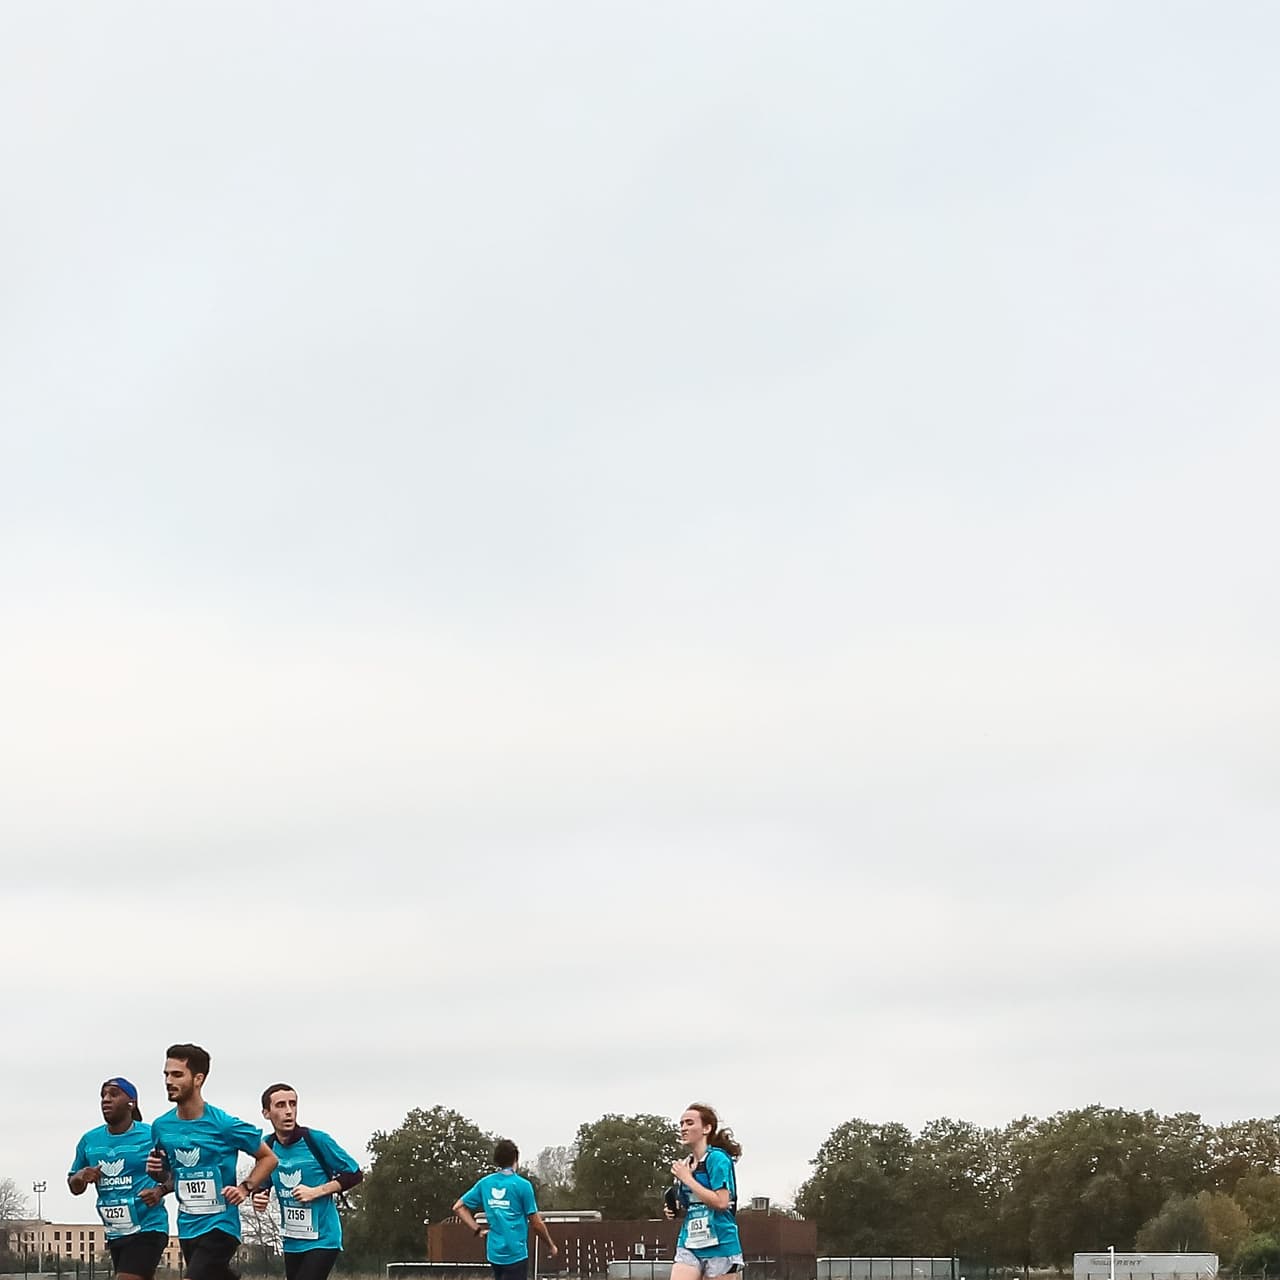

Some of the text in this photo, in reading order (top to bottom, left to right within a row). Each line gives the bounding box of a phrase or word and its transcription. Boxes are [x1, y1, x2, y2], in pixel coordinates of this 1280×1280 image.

[186, 1181, 207, 1194] 1812
[104, 1207, 124, 1218] 2252
[287, 1209, 306, 1221] 2156
